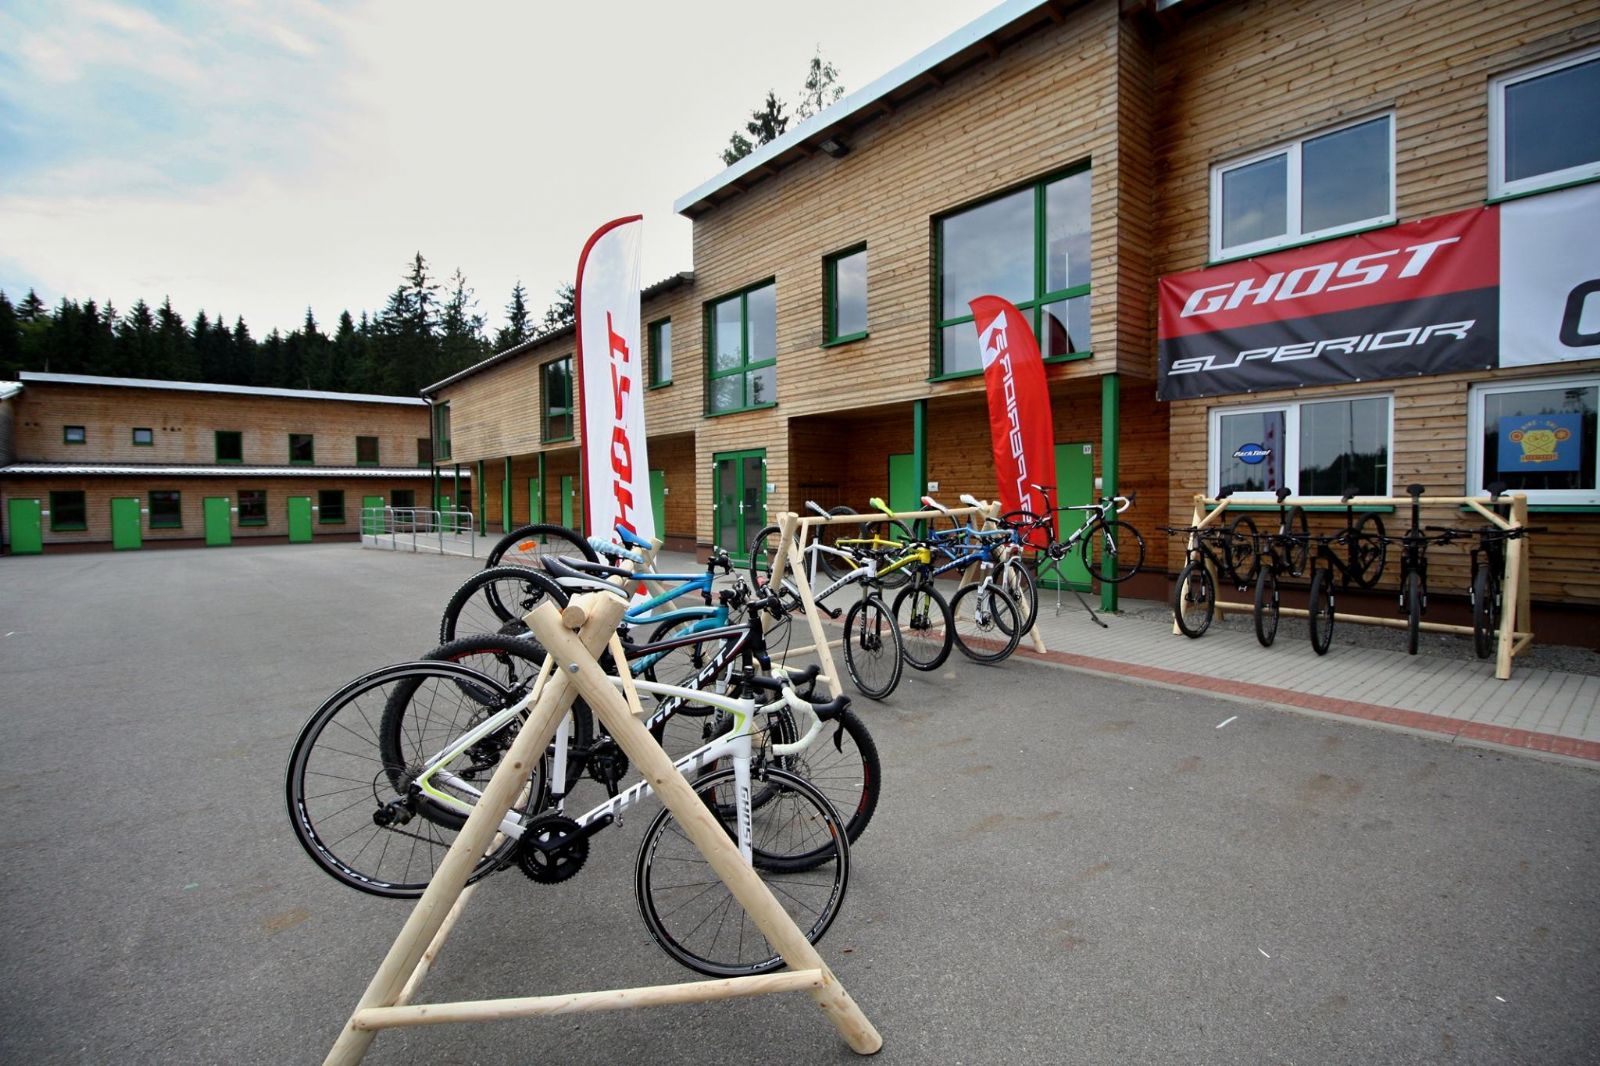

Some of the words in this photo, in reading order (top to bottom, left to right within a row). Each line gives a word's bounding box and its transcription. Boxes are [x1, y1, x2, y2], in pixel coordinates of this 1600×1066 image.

[1180, 236, 1461, 318] GHOST
[1167, 319, 1477, 376] SUPERIOR
[606, 310, 639, 567] HOST
[741, 785, 753, 851] GHOST
